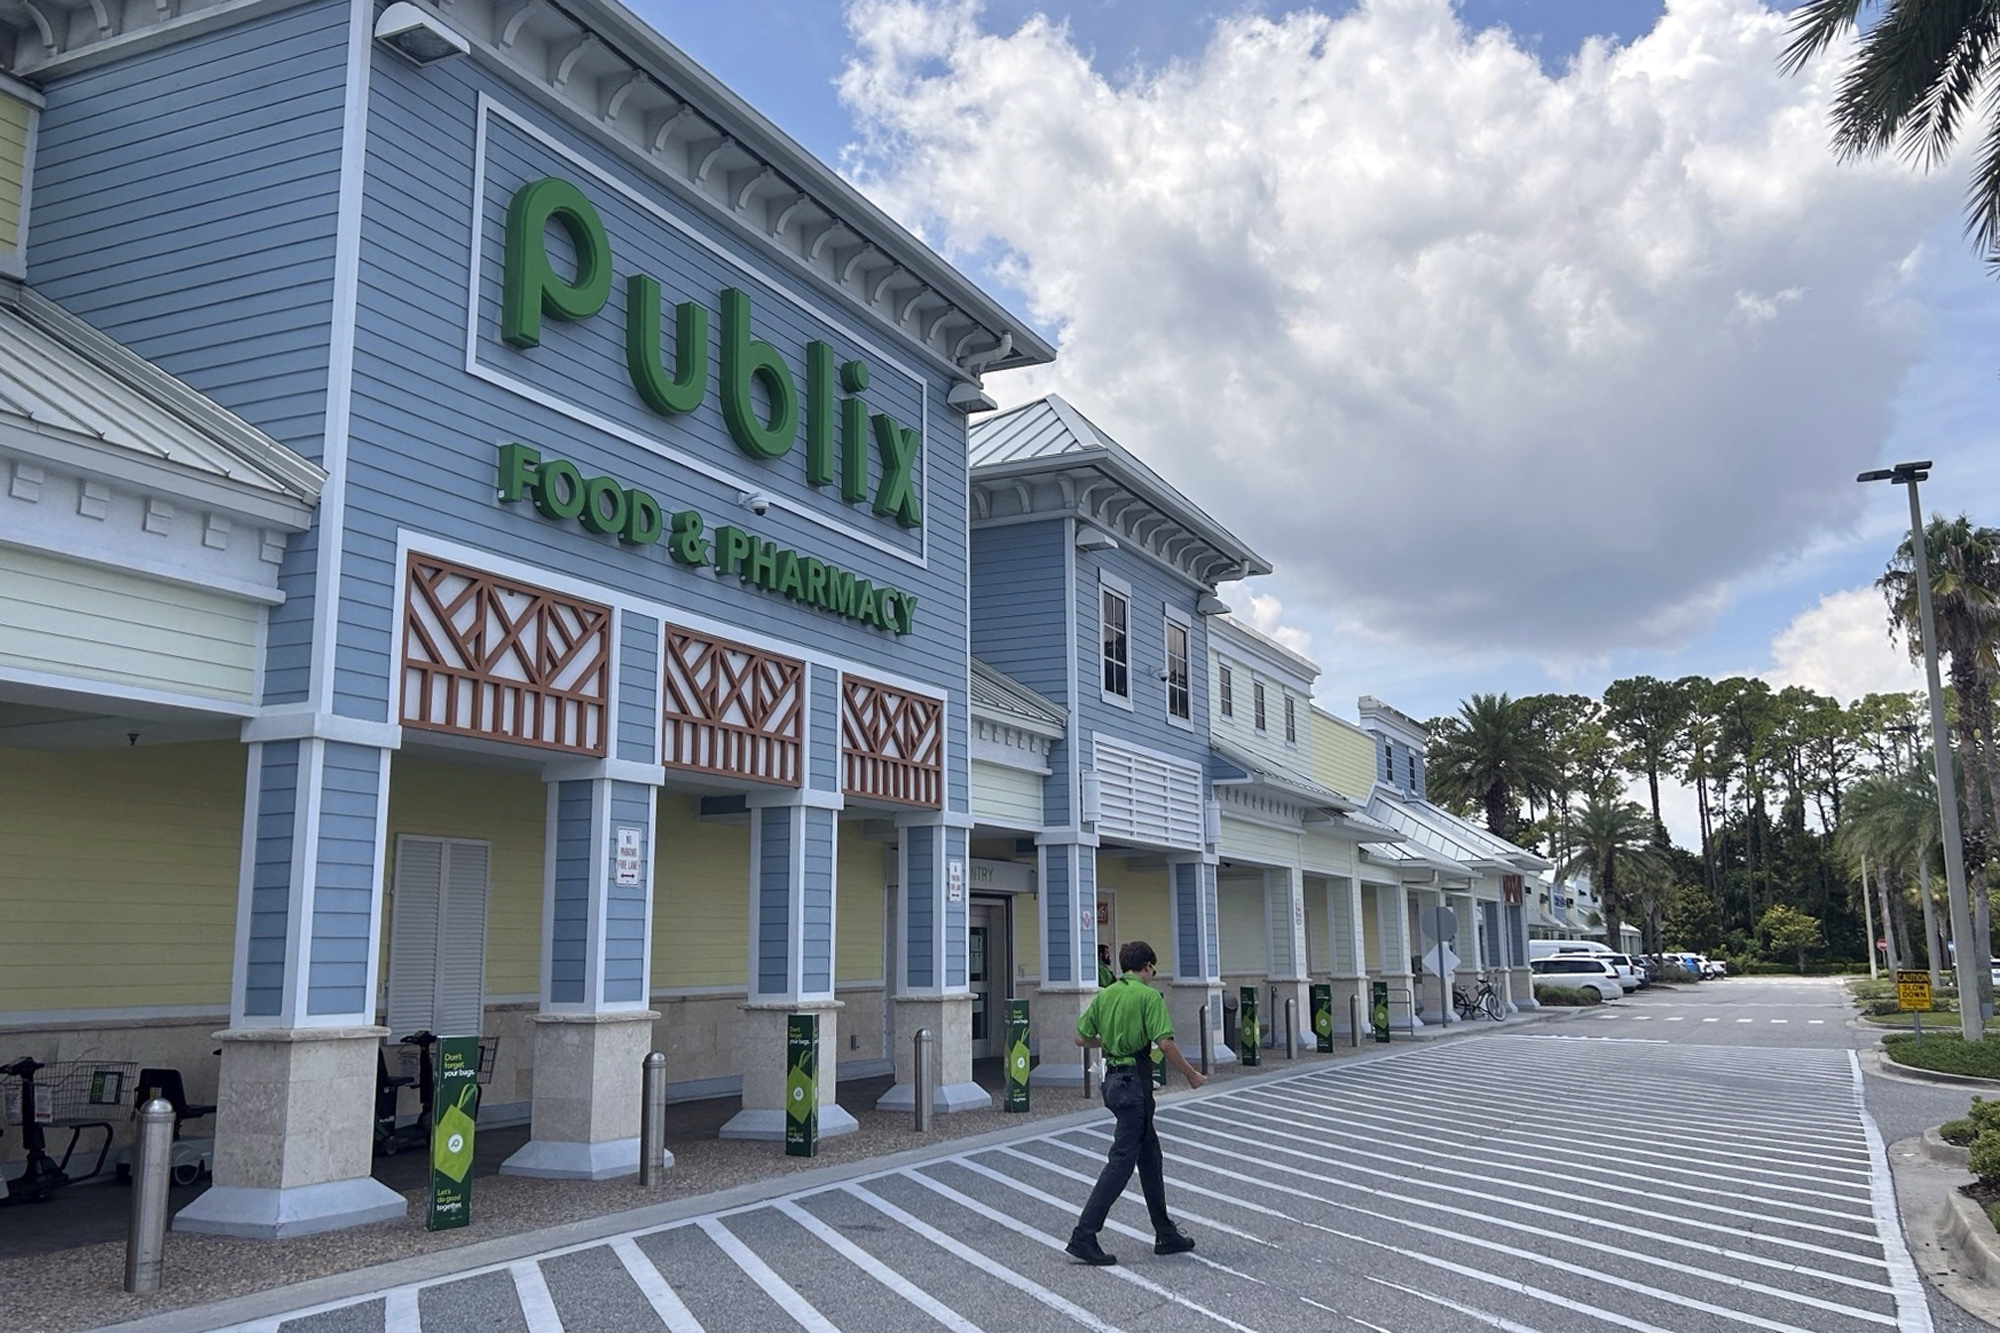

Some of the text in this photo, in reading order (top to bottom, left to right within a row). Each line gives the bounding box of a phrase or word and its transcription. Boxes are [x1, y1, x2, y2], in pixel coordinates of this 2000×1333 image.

[501, 177, 922, 528] Publix
[499, 442, 919, 635] FOOD & PHARMACY
[969, 866, 994, 882] NTRY
[1897, 973, 1929, 982] CAUTION
[444, 1053, 463, 1061] Don't
[444, 1061, 465, 1070] forget
[443, 1070, 459, 1079] your
